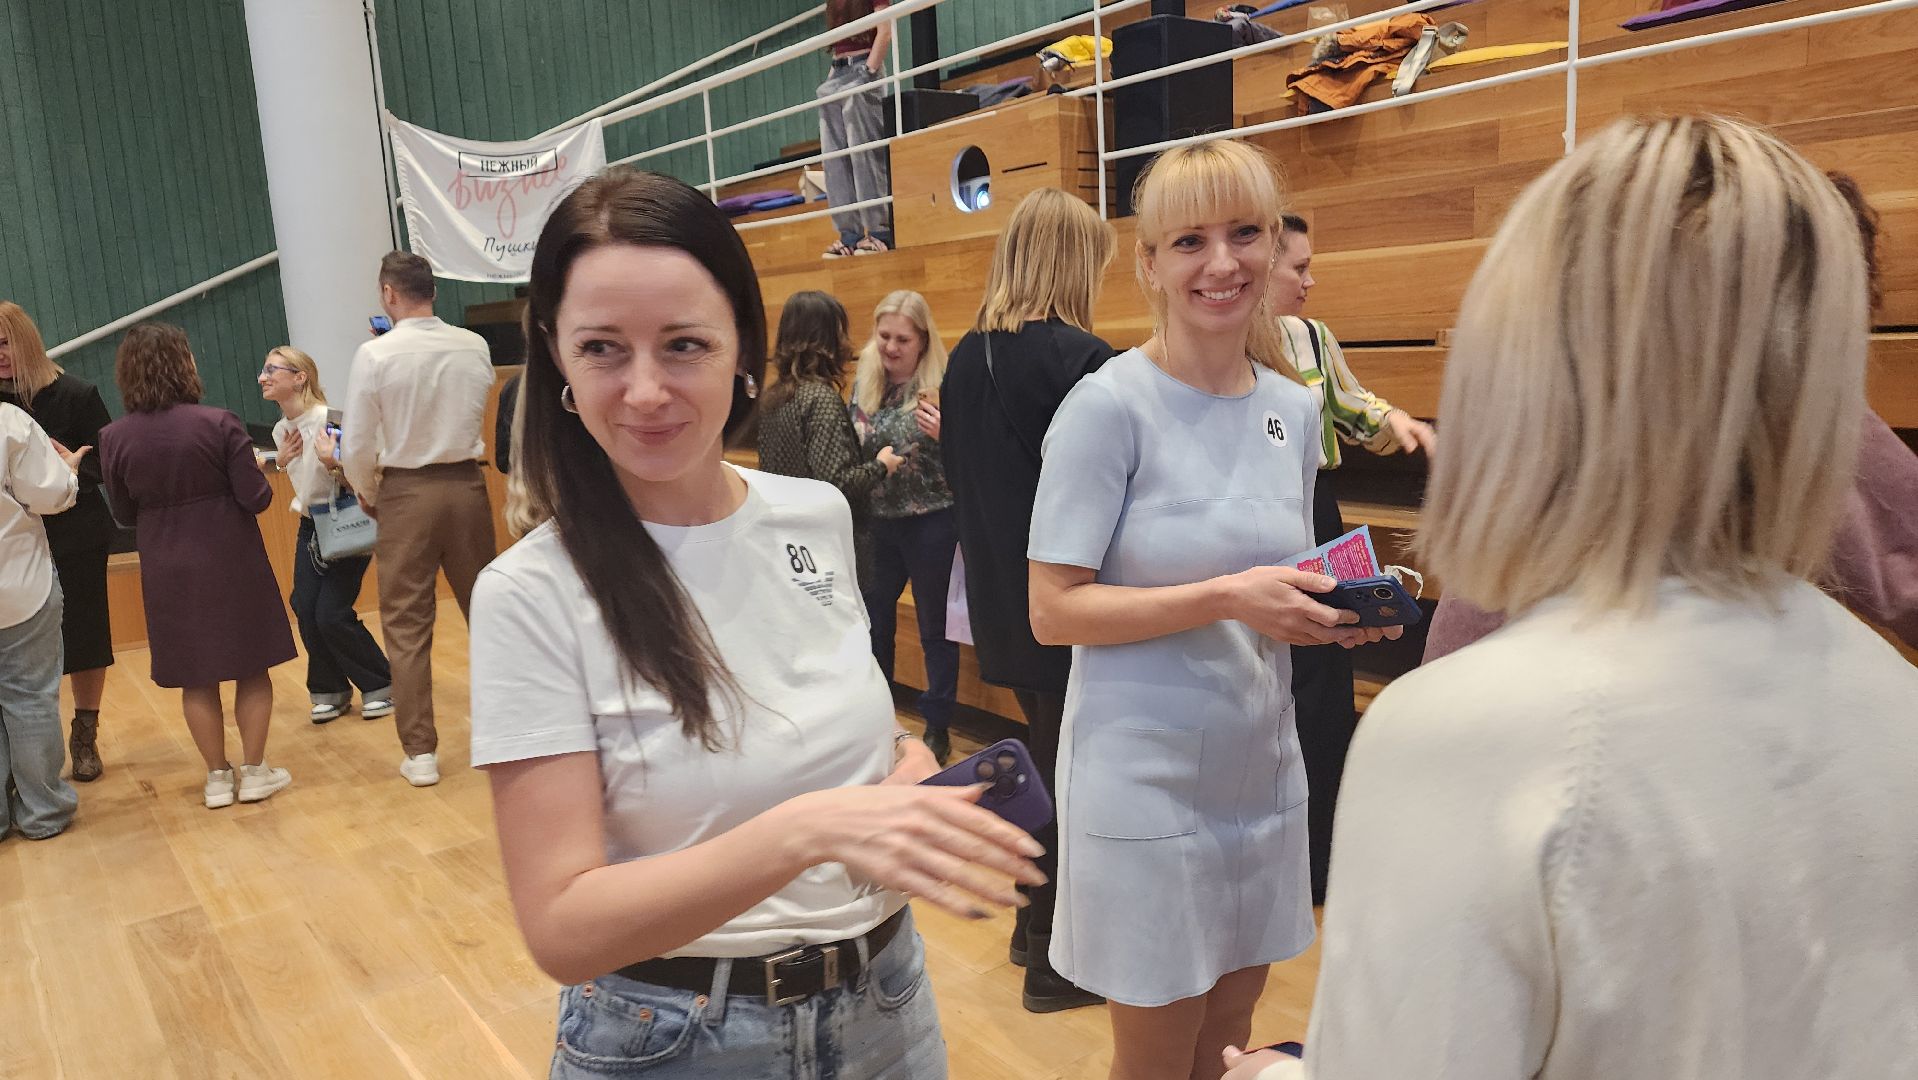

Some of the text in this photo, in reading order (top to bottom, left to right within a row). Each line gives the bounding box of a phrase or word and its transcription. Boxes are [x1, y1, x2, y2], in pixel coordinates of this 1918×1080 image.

[480, 155, 538, 173] НЕЖНЫЙ
[1267, 417, 1285, 441] 46
[786, 543, 817, 574] 80
